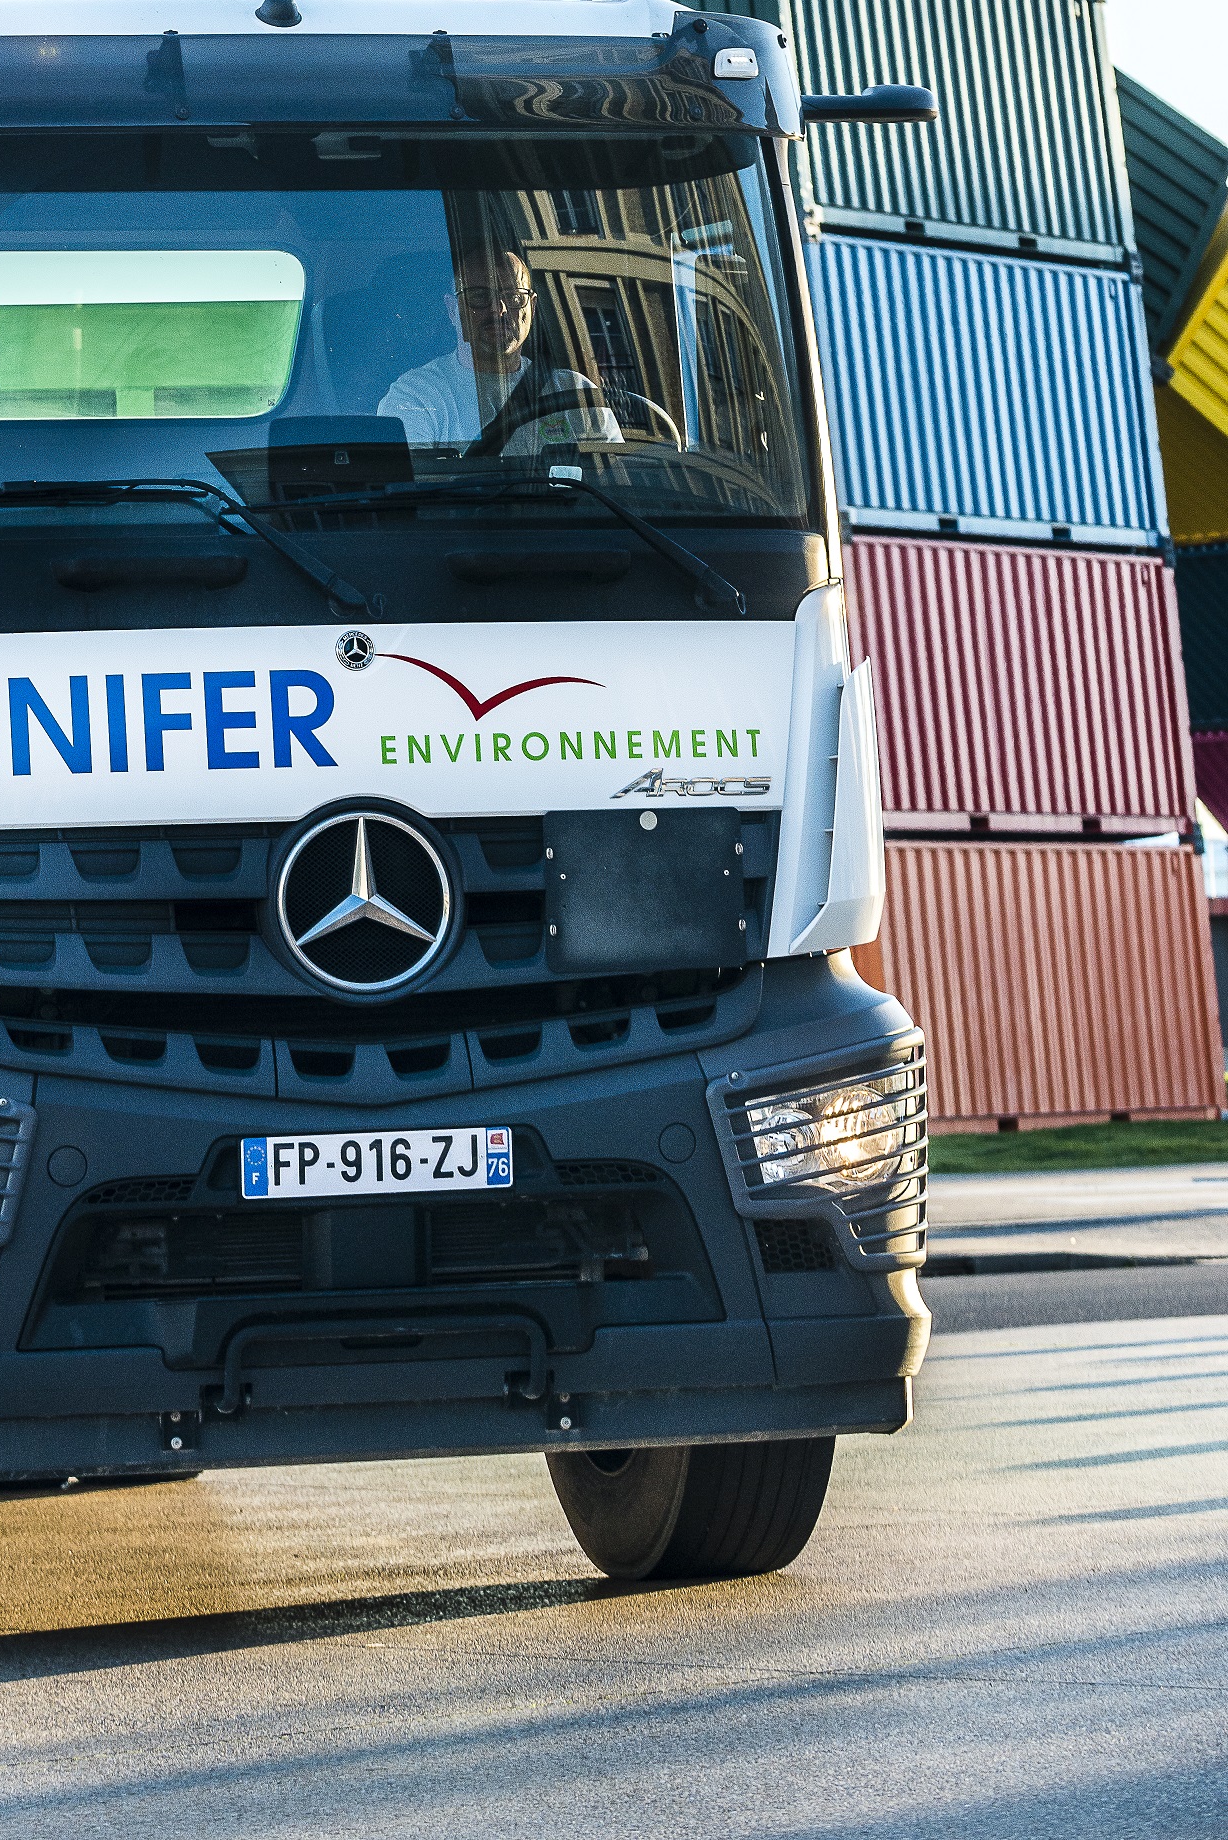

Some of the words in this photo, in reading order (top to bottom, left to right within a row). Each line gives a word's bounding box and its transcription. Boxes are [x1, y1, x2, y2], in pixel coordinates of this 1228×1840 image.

[380, 728, 762, 765] ENVIRONNEMENT
[272, 1134, 480, 1187] FP-916-ZJ
[487, 1157, 510, 1178] 76
[251, 1172, 261, 1186] F
